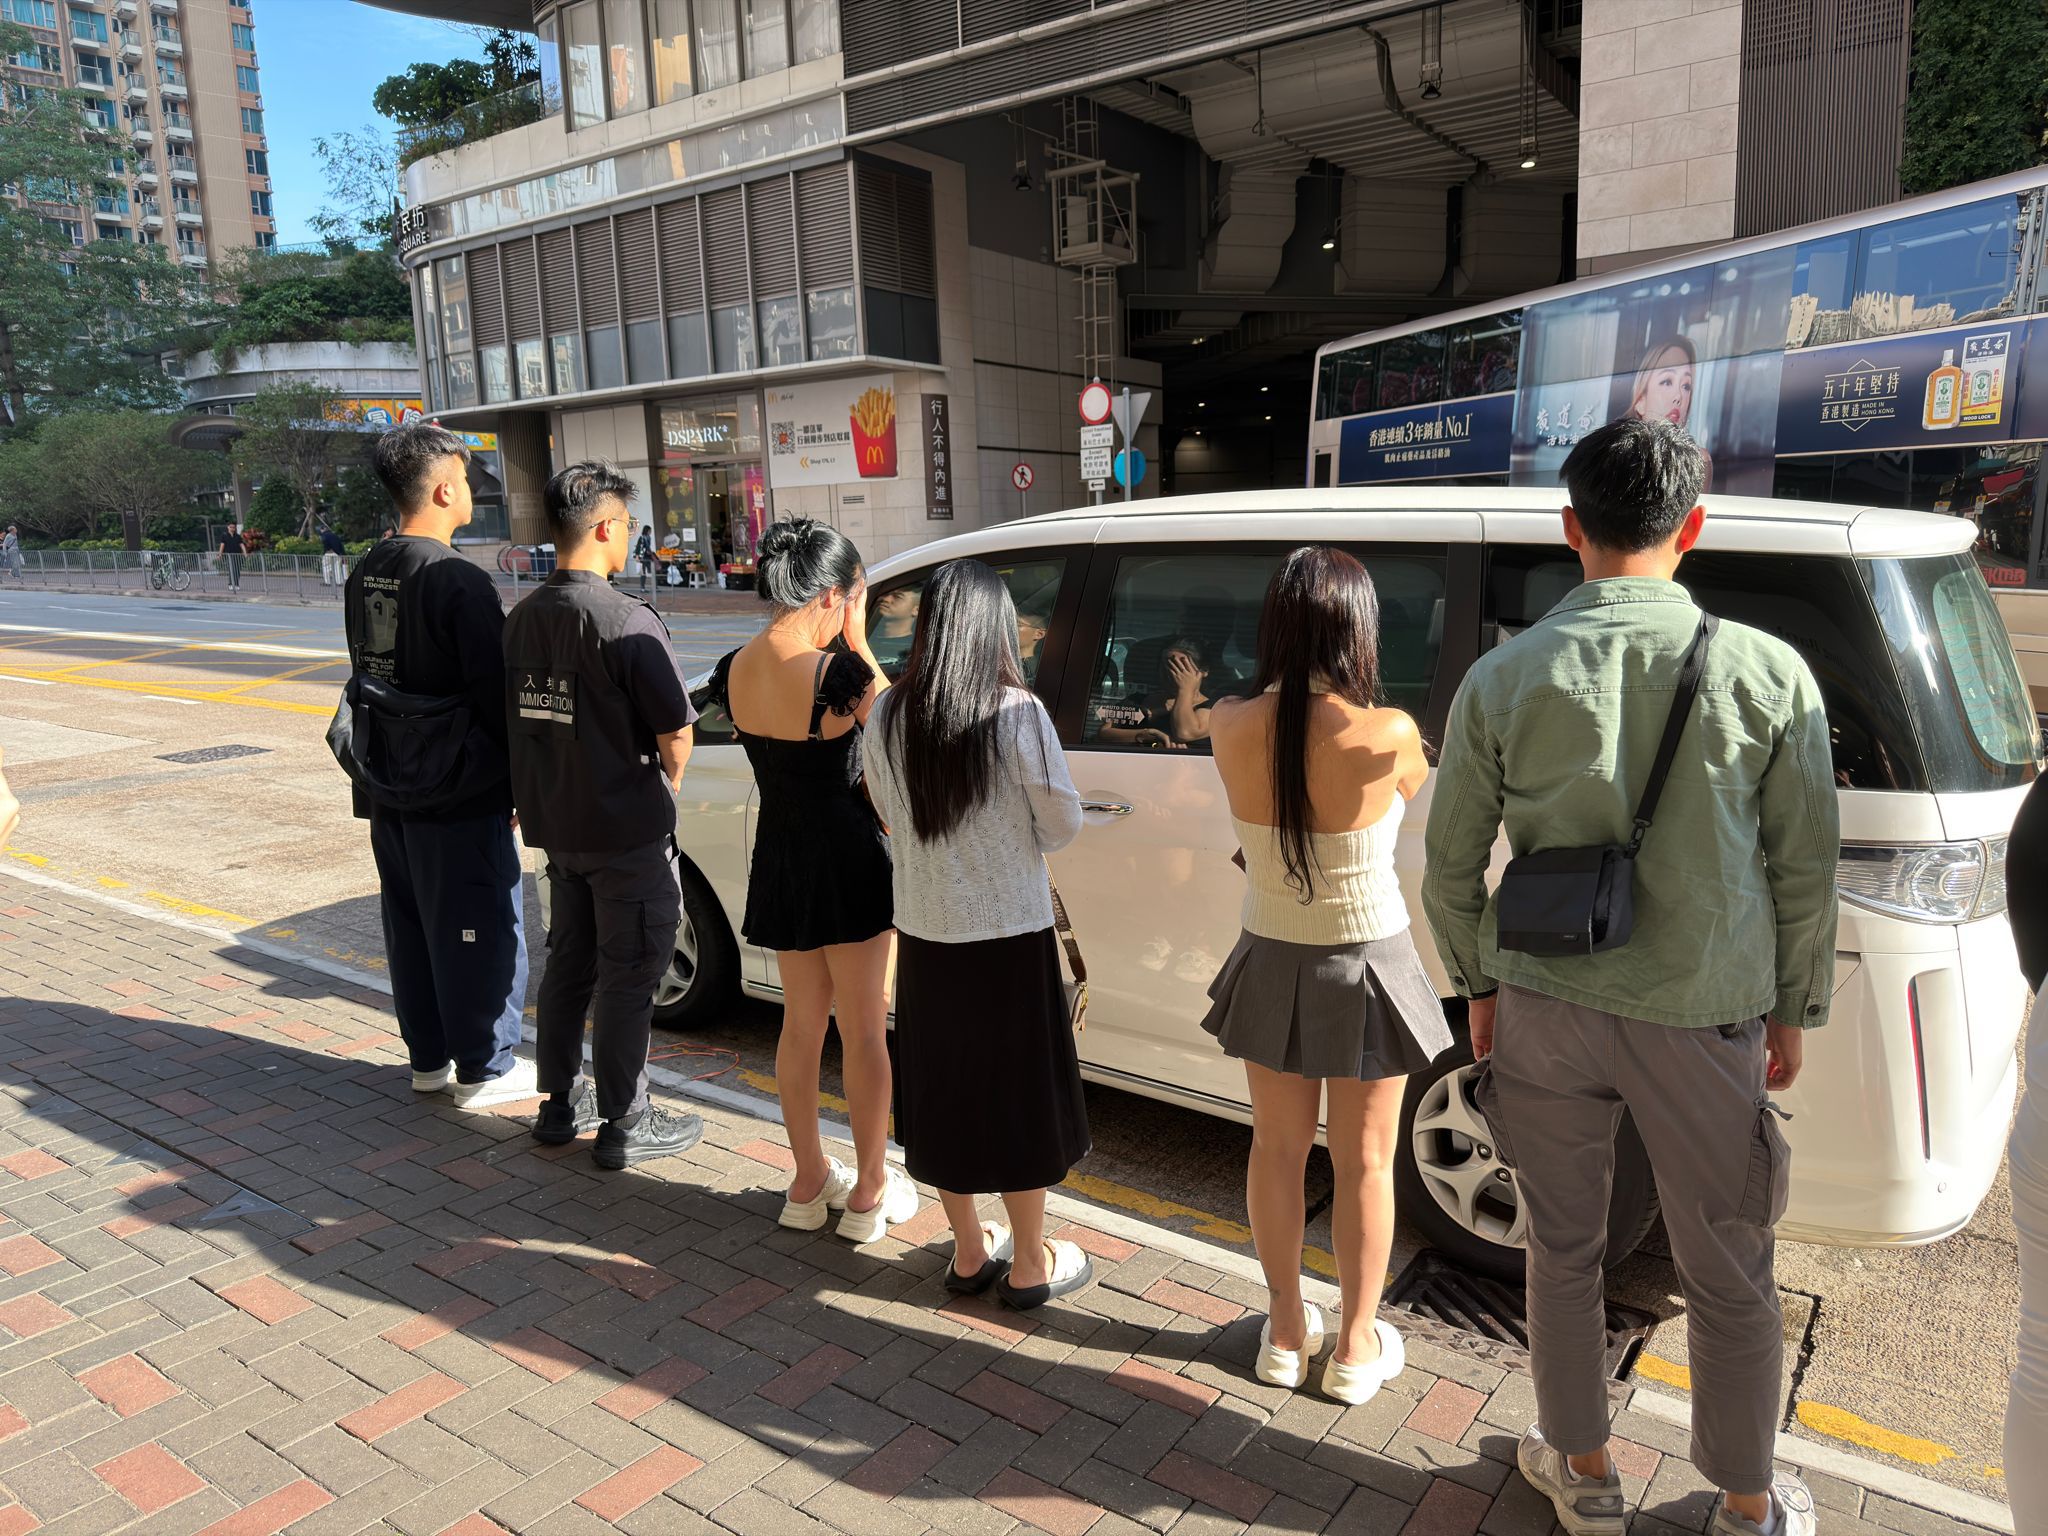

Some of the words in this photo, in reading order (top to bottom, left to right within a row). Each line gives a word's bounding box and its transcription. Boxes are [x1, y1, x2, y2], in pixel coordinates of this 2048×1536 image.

[397, 205, 425, 234] 民坊
[1822, 372, 1900, 400] 五十年堅持
[1821, 403, 1860, 420] 香港製造
[1878, 407, 1895, 415] KONG
[668, 425, 724, 446] DSPARK
[930, 399, 947, 501] 行人不得內進
